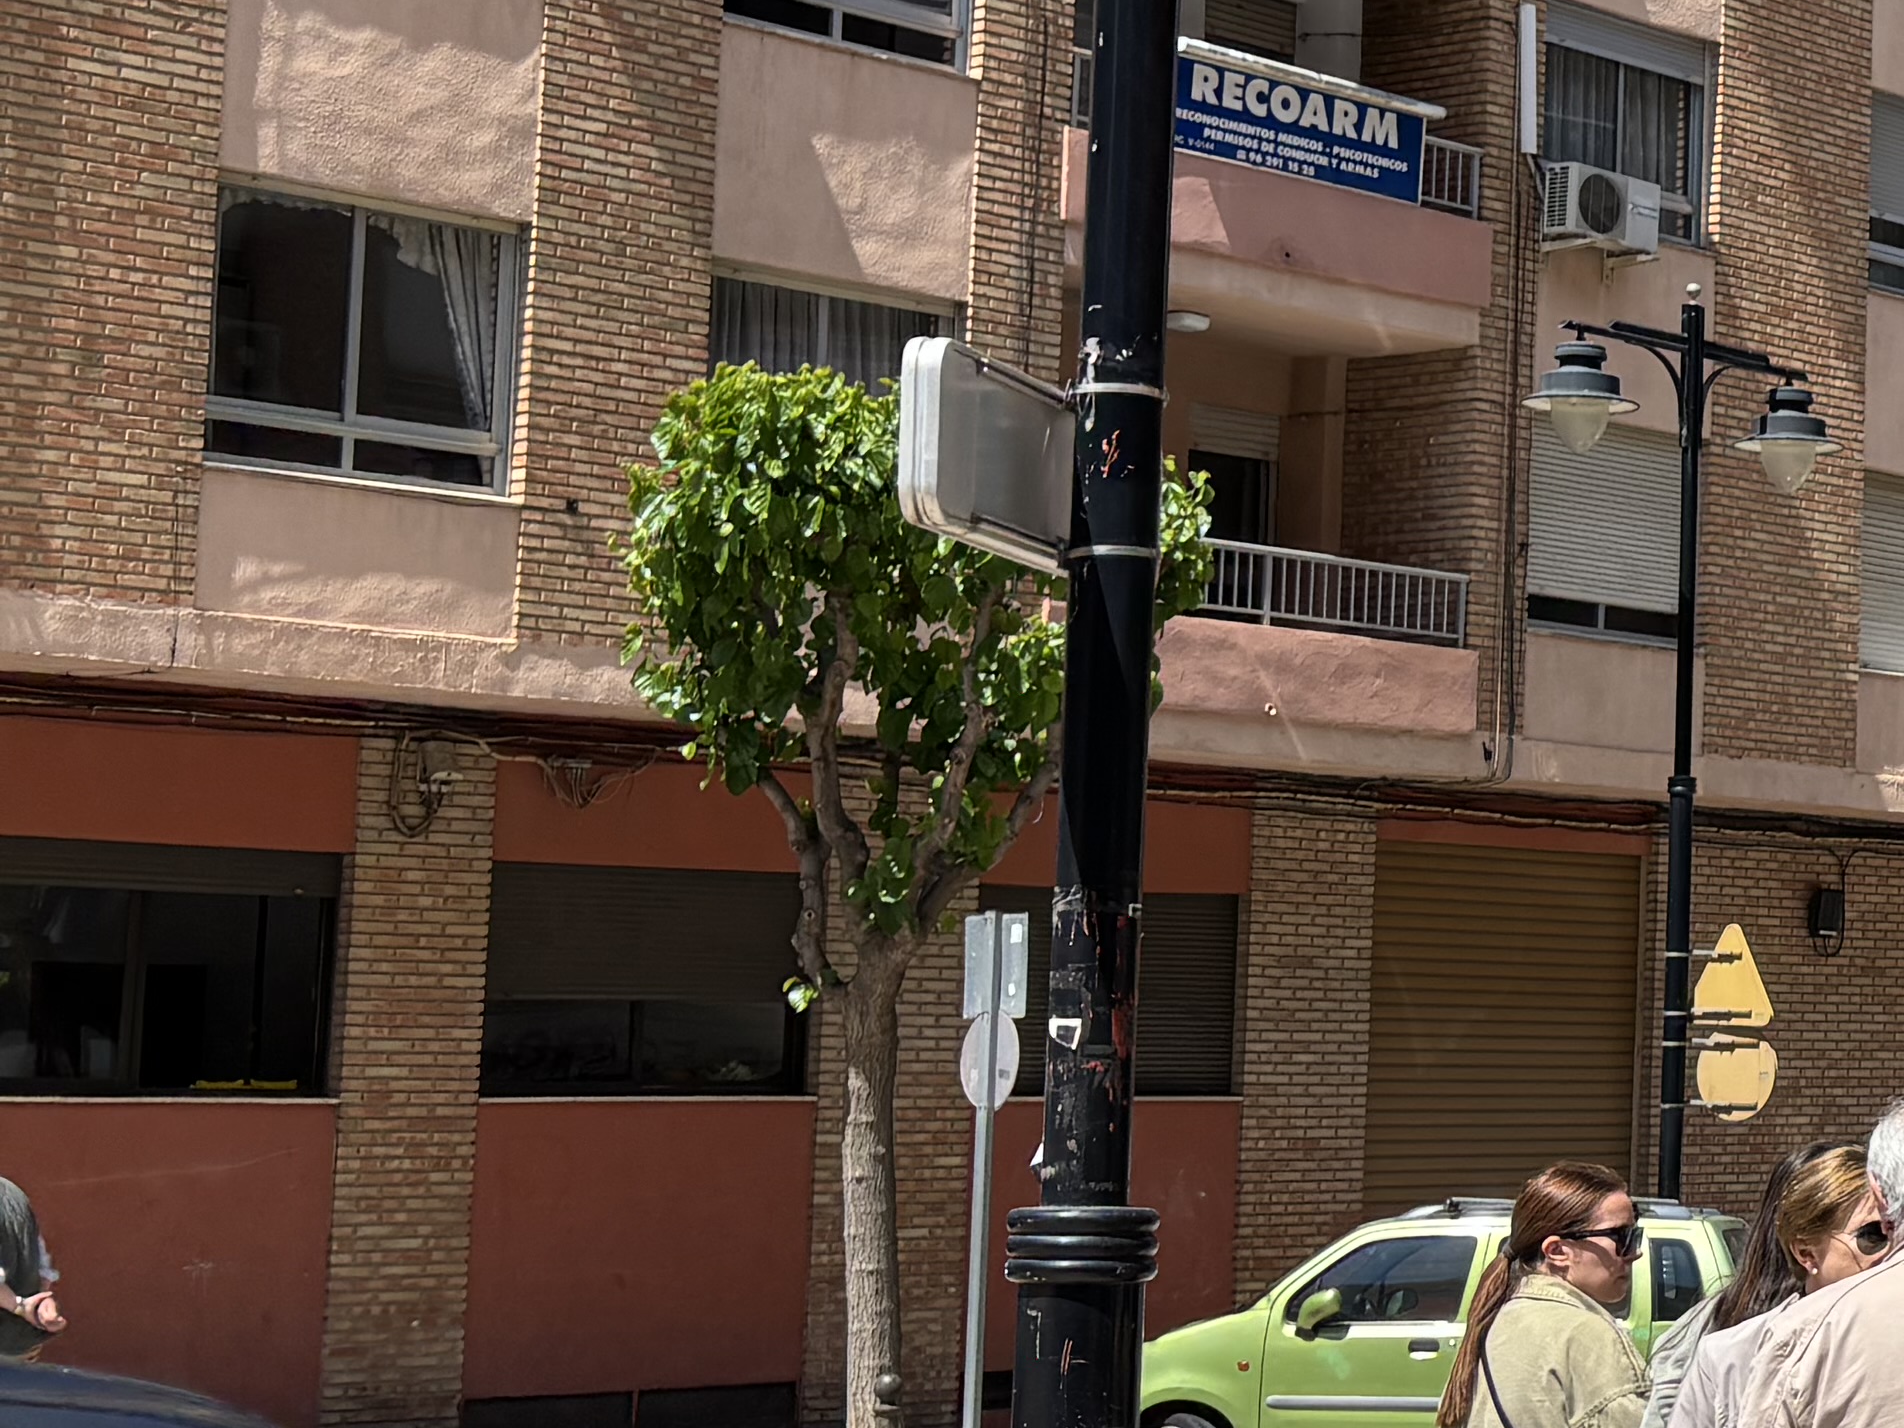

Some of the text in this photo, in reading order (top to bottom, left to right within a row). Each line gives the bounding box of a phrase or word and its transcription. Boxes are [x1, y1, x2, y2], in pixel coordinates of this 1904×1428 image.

[1191, 63, 1398, 149] RECOARM
[1203, 127, 1259, 150] PERMISOS
[1261, 141, 1275, 153] DE
[1331, 158, 1338, 169] Y
[1340, 160, 1380, 179] ARMAS
[1248, 152, 1263, 164] 96
[1277, 132, 1323, 152] MEDICOS
